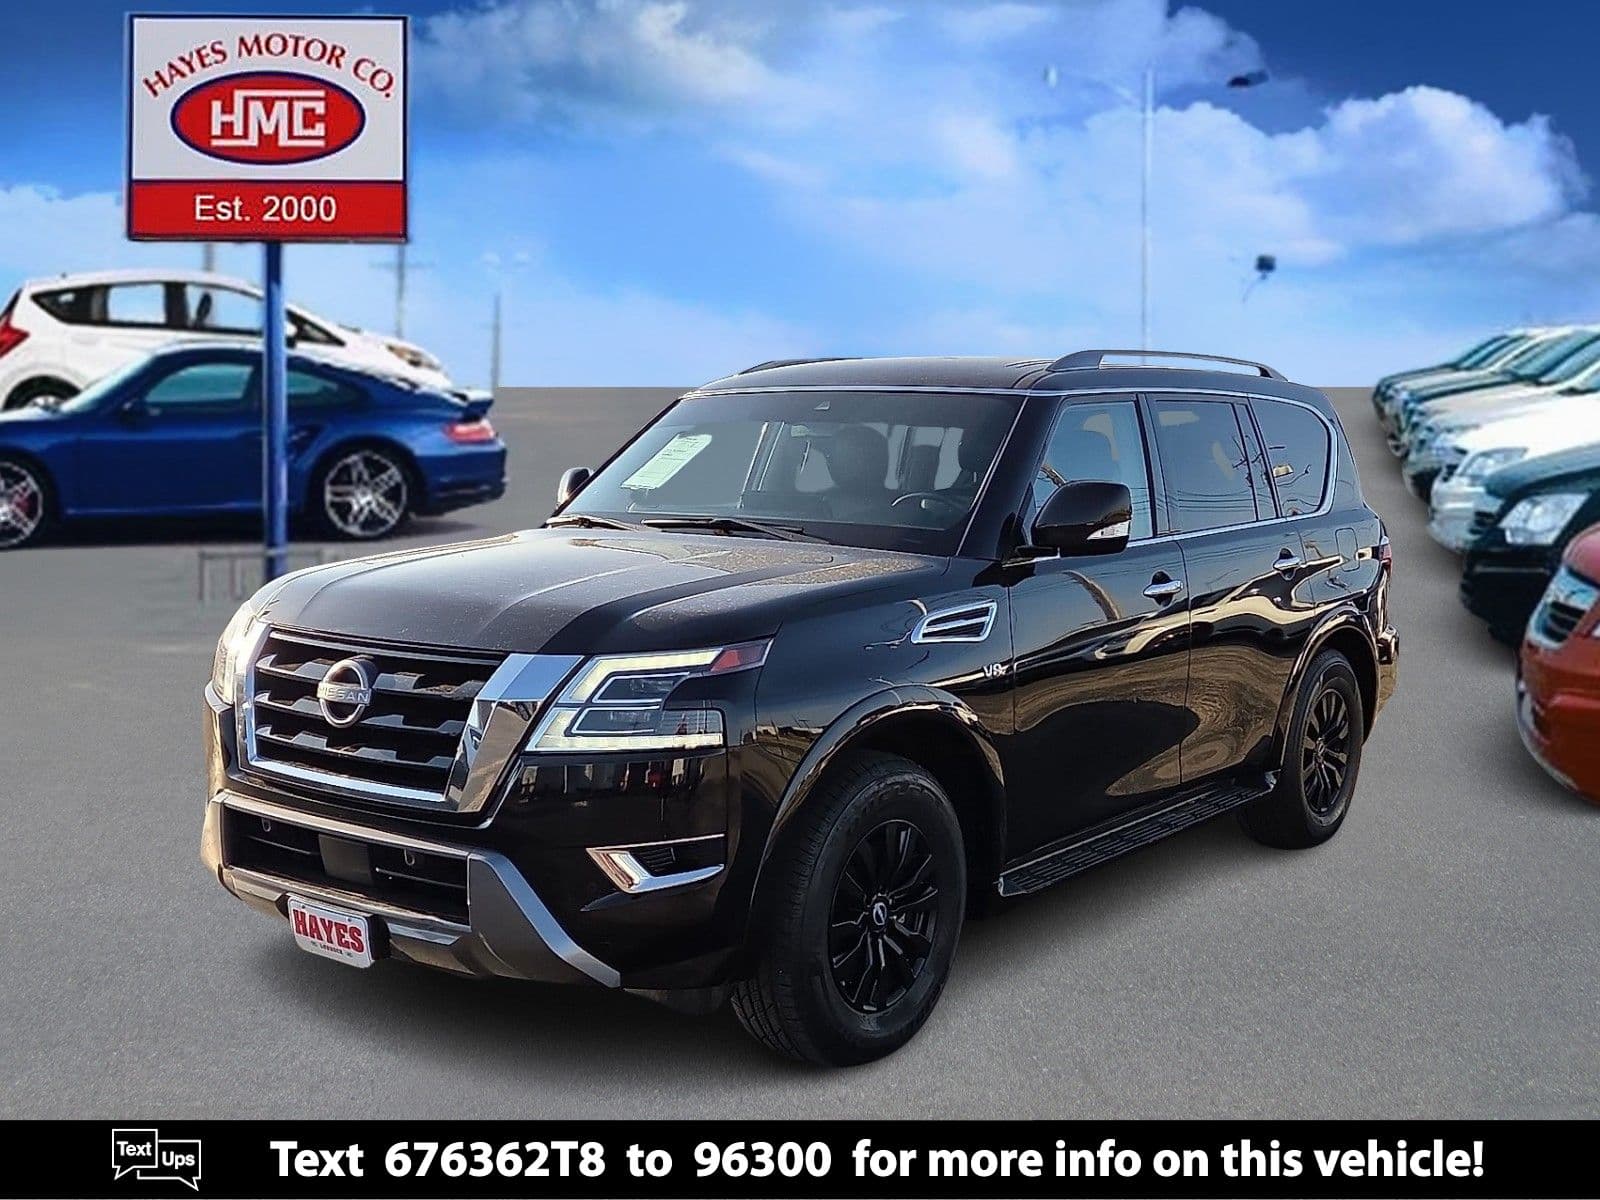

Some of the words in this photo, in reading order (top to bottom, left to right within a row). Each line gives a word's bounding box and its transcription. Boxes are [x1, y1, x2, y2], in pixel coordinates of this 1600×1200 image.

[142, 41, 228, 98] HAYES
[238, 33, 346, 69] MOTOR
[352, 57, 395, 99] CO.
[210, 89, 326, 147] HMC
[194, 195, 251, 222] Est.
[262, 195, 337, 222] 2000
[293, 909, 365, 953] HAYES
